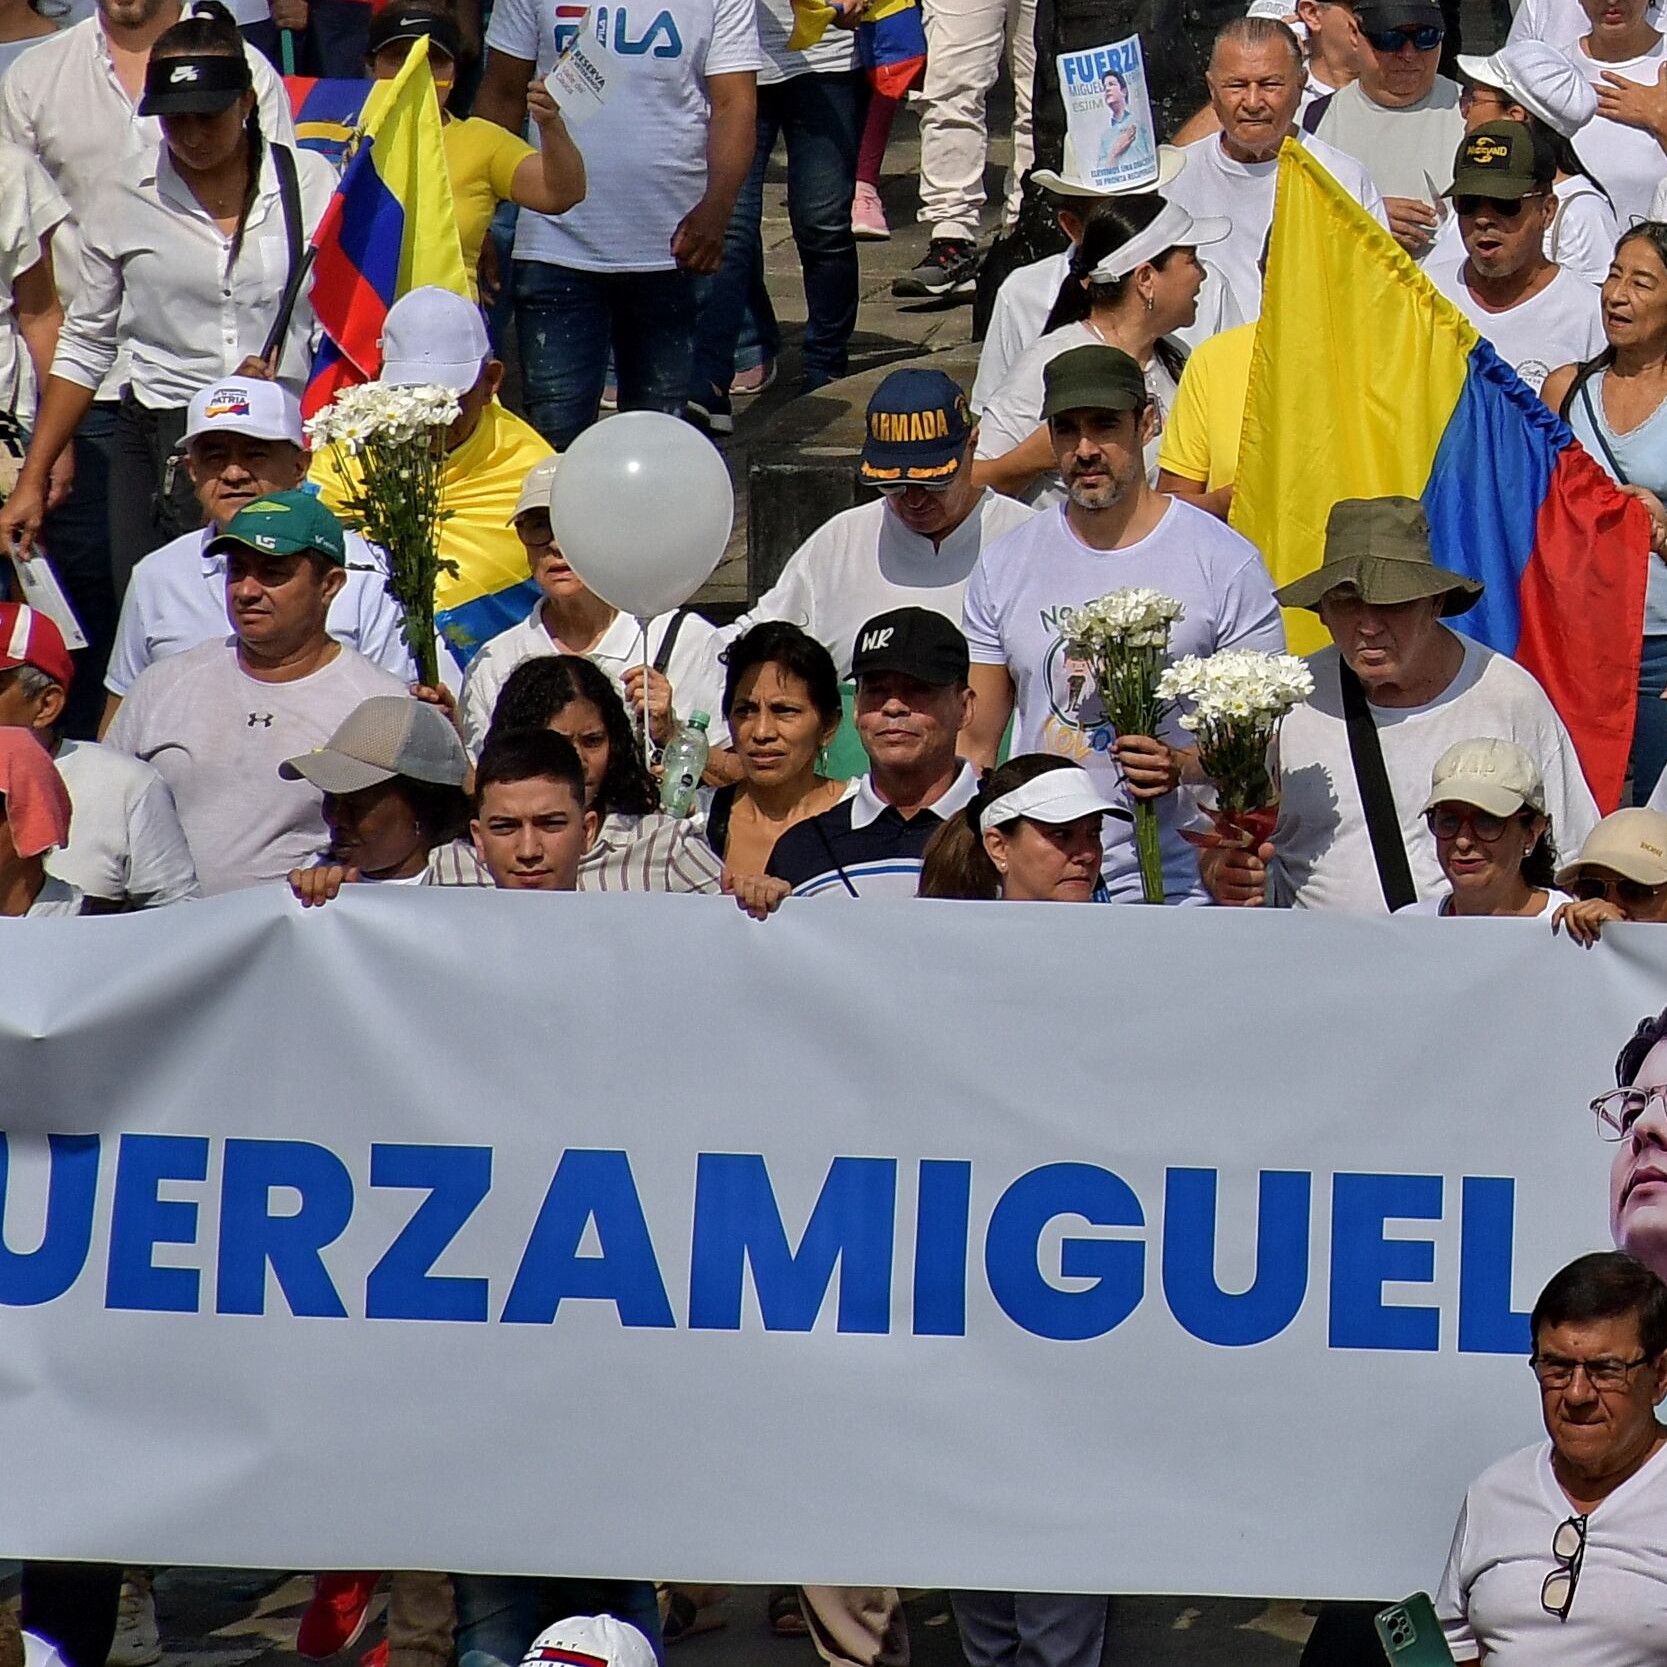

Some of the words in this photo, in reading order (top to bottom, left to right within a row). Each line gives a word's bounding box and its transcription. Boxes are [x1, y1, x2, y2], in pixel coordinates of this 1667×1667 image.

[555, 5, 682, 57] FILA
[574, 50, 606, 90] RESERVA
[210, 396, 247, 406] PATRIA
[871, 411, 949, 442] ARMADA
